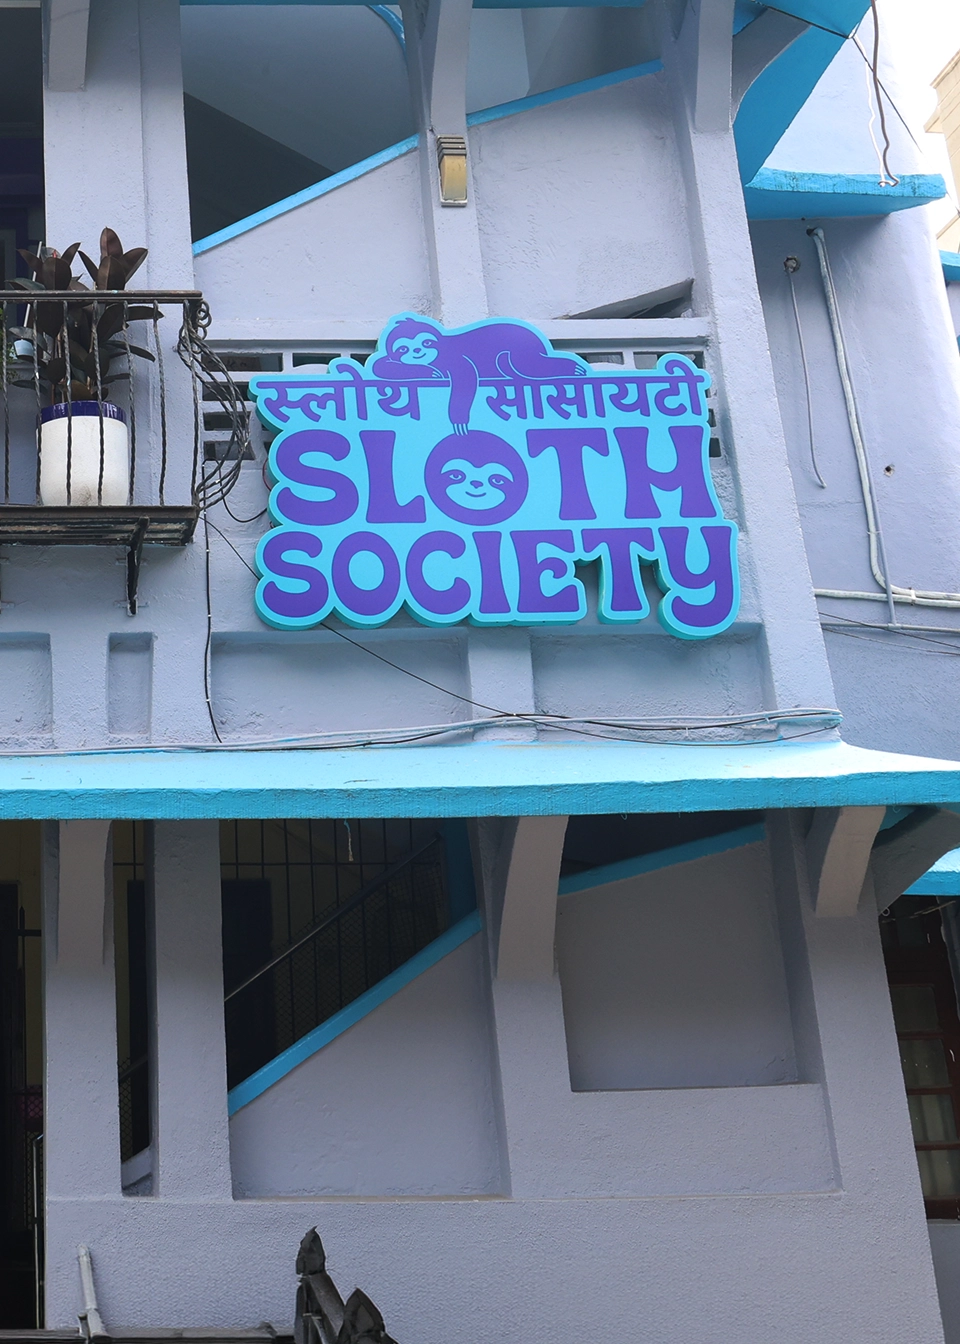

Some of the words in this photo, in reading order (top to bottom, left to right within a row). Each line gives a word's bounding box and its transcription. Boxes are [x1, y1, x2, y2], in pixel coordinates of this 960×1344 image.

[256, 363, 435, 423] स्लोथ
[276, 424, 717, 526] SLOTH
[262, 526, 733, 627] SOCIETY
